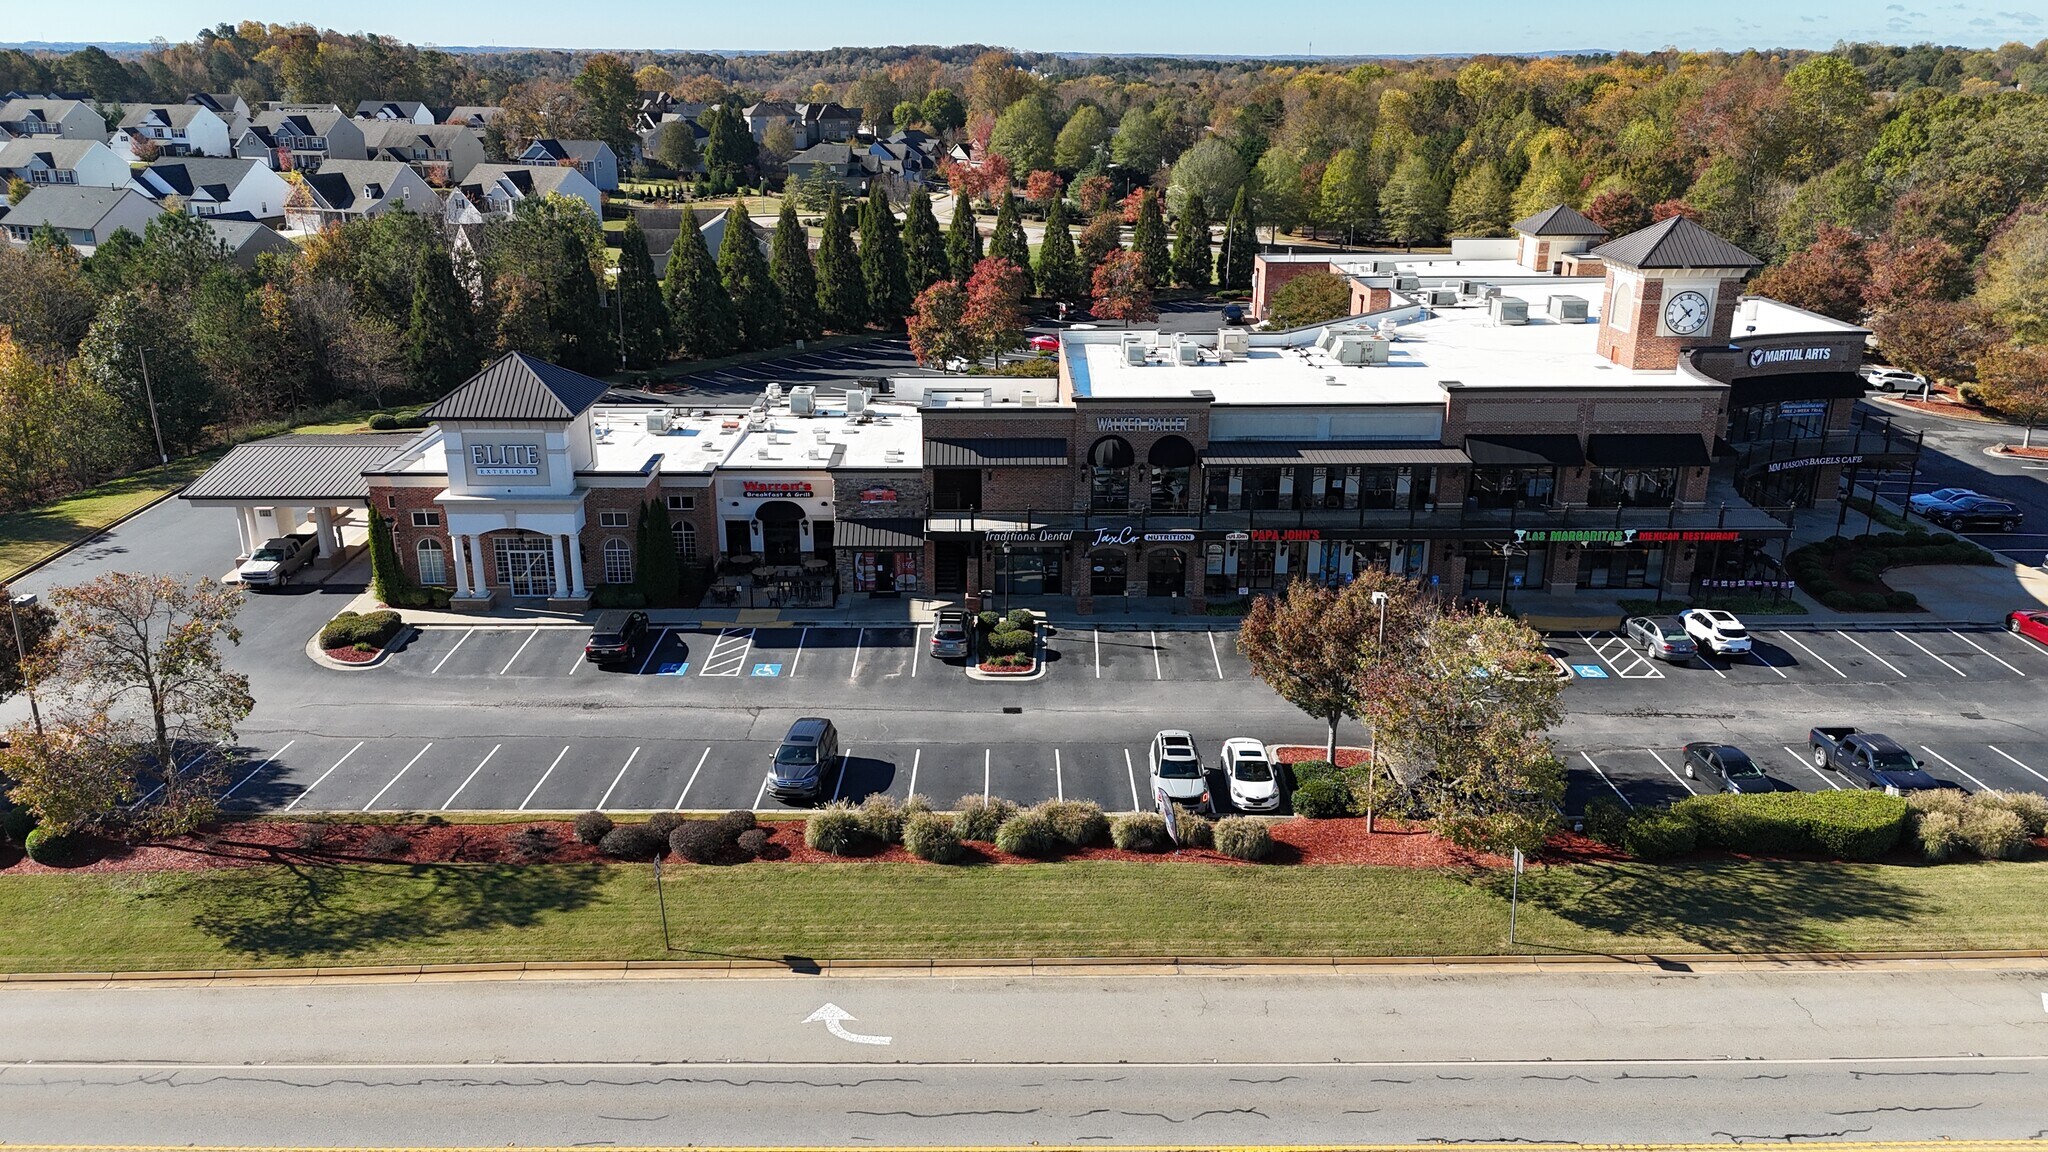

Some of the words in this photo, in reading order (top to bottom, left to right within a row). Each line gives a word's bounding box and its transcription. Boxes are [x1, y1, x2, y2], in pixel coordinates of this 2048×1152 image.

[1764, 349, 1804, 362] MARTIAL
[1805, 348, 1831, 360] ARTS
[1097, 417, 1142, 431] WALKER
[1148, 417, 1189, 431] BALLET
[470, 445, 540, 465] ELITE
[1809, 456, 1840, 465] BAGELS
[743, 481, 812, 491] Warren's
[985, 530, 1036, 542] Traditions
[1039, 530, 1074, 542] Dental
[1252, 530, 1280, 541] PAPA
[1281, 530, 1320, 541] JOHN'S
[1526, 531, 1545, 541] LAS
[1550, 530, 1623, 541] MARGARITAS
[1639, 531, 1680, 541] MEXICAN
[1682, 531, 1740, 541] RESTAURANT
